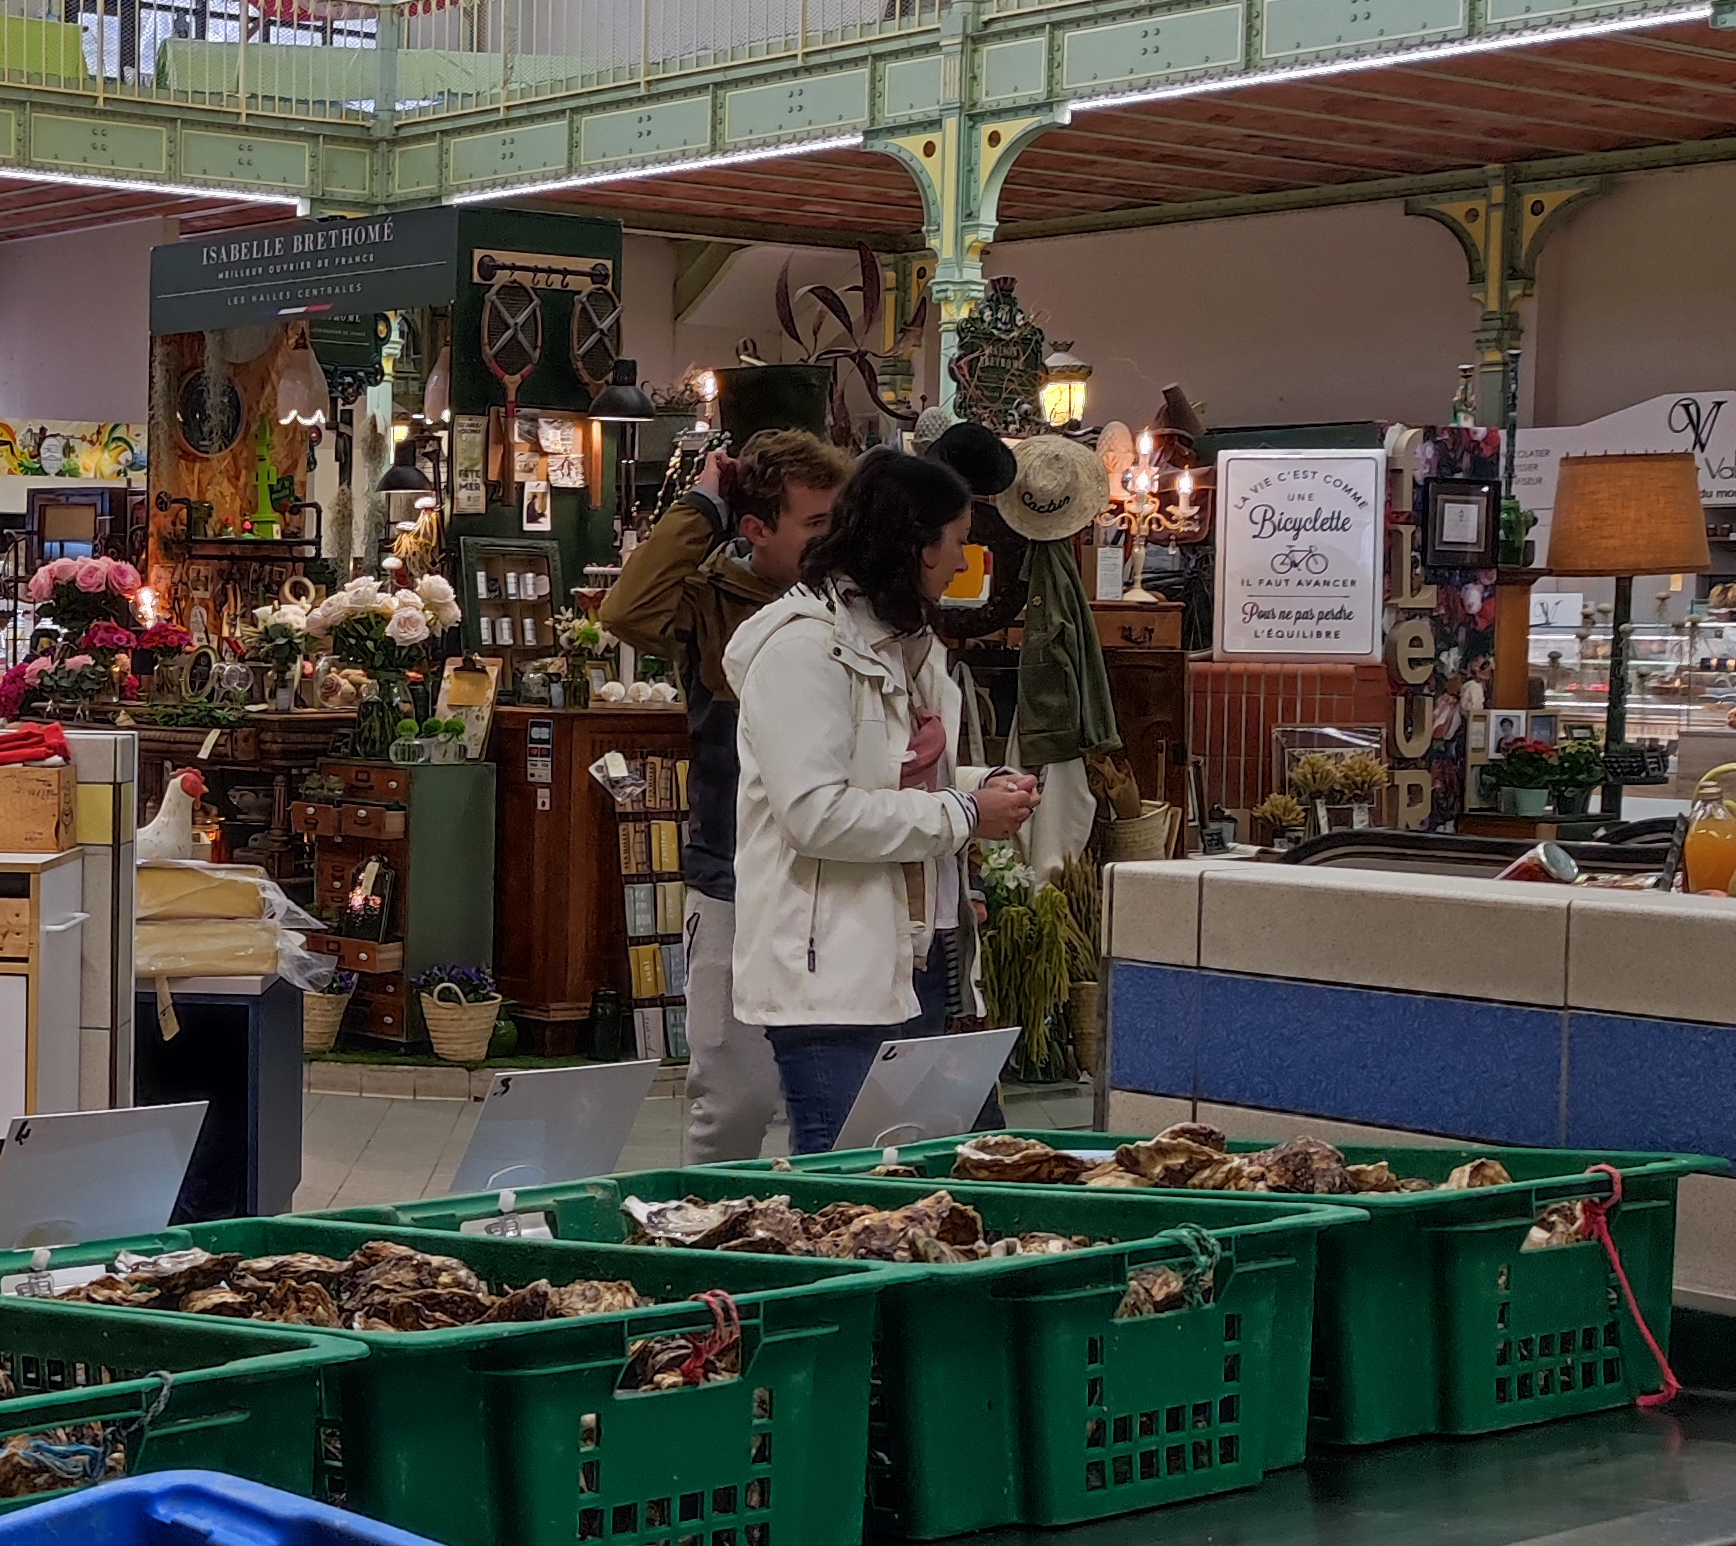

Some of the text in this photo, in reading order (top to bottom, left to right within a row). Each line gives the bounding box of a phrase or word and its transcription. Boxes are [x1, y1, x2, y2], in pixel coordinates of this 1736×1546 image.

[202, 217, 394, 265] ISABELLE BRETHOMÉ
[218, 253, 374, 280] MEILLEUR OUVRIER DE FRANCE
[227, 282, 363, 306] LES HALLES CENTRALES
[1234, 469, 1368, 510] LA VIE C'EST COMME
[1287, 493, 1314, 502] UNE
[1249, 504, 1352, 541] Bicyclette
[1241, 578, 1357, 588] IL FAUT AVANCER
[1242, 602, 1355, 625] Pour ne pas perdre
[1254, 628, 1341, 639] L'ÉQUILIBRE
